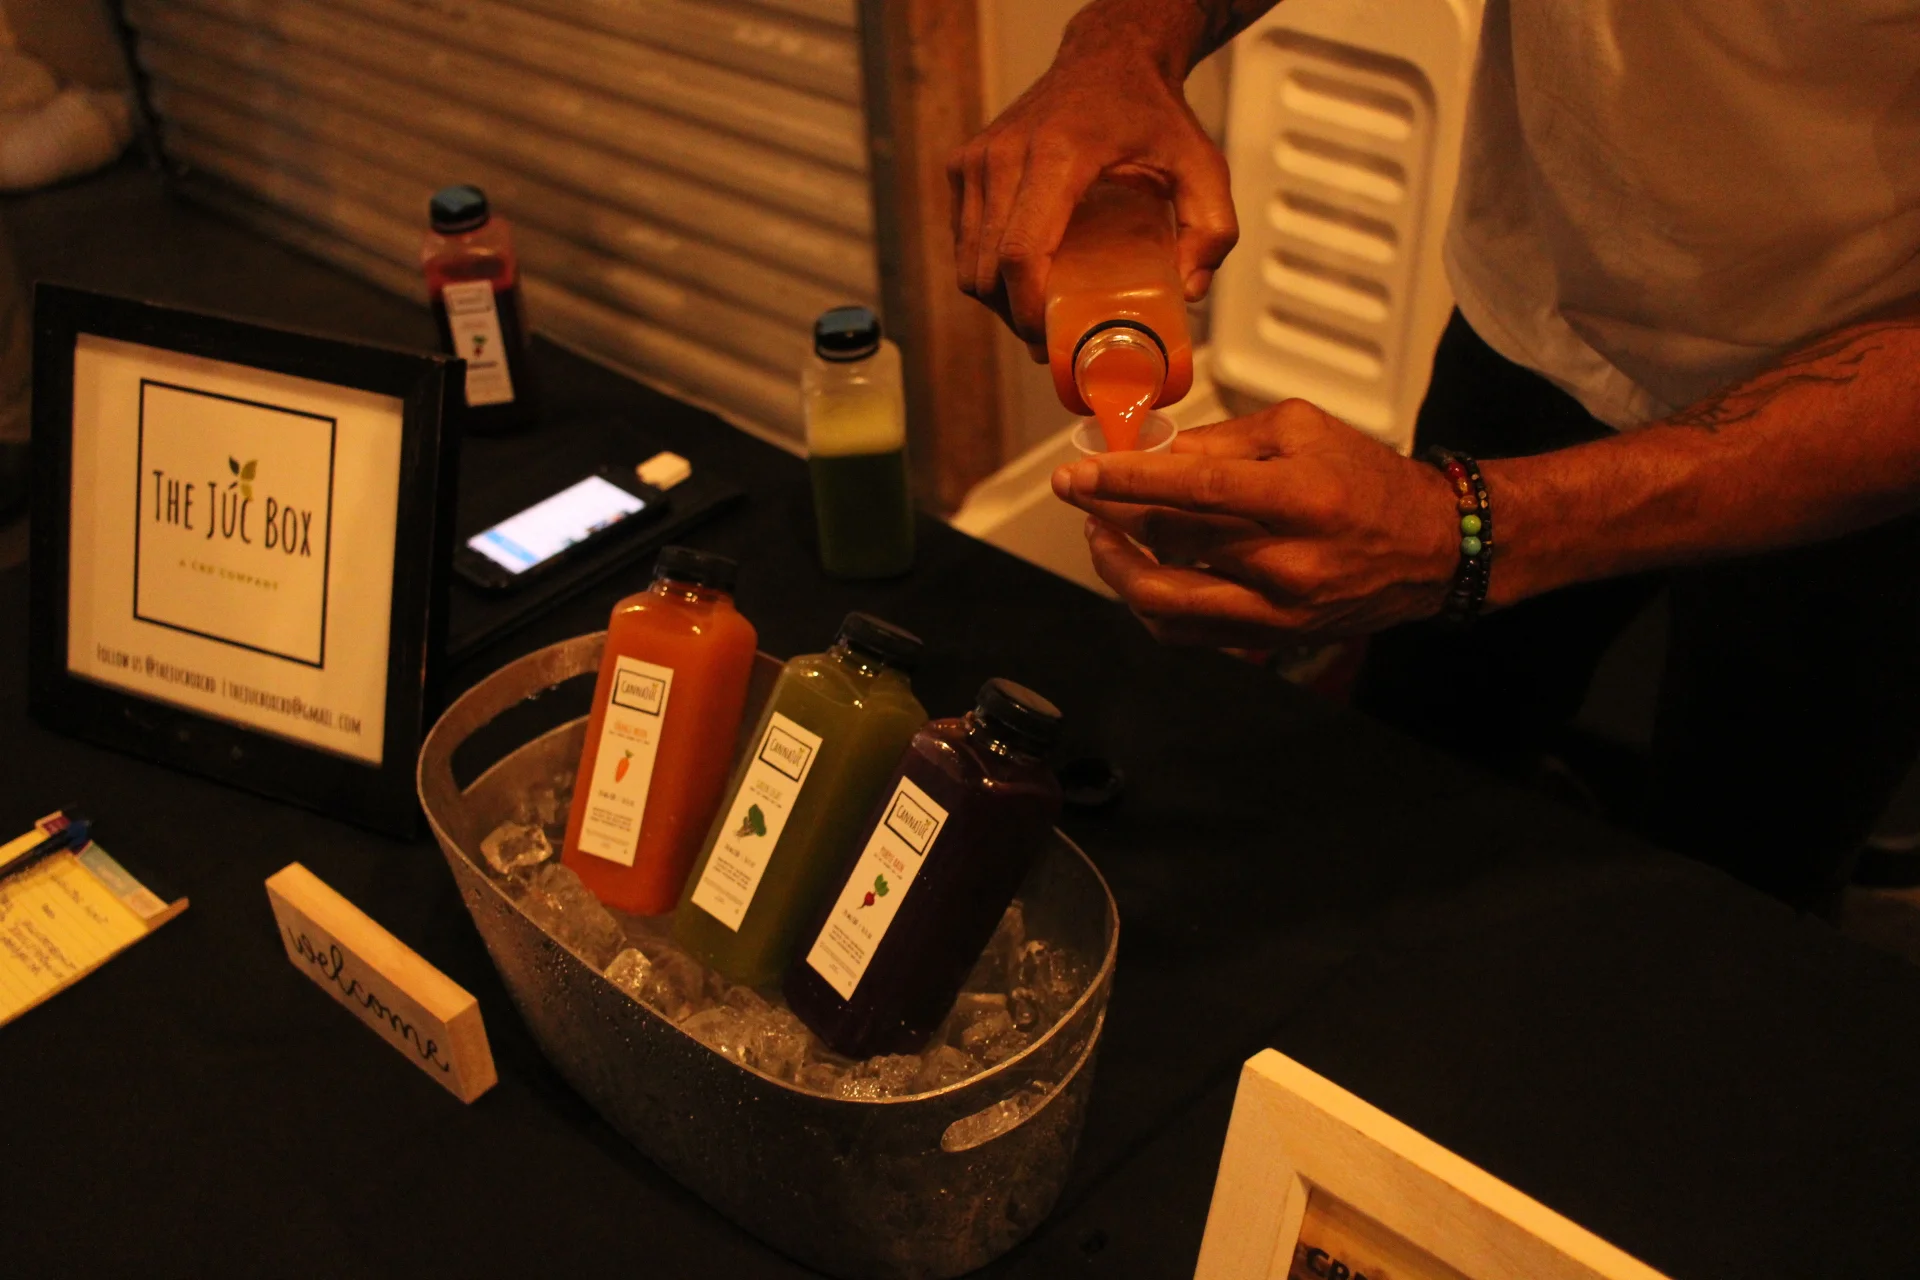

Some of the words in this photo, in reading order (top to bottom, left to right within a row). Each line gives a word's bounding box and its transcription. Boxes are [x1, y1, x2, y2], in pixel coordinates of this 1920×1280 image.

[153, 469, 195, 530] THE
[265, 496, 312, 557] BOX
[219, 567, 278, 590] COMPANY
[287, 927, 450, 1073] welcome
[1305, 1247, 1370, 1280] CB
